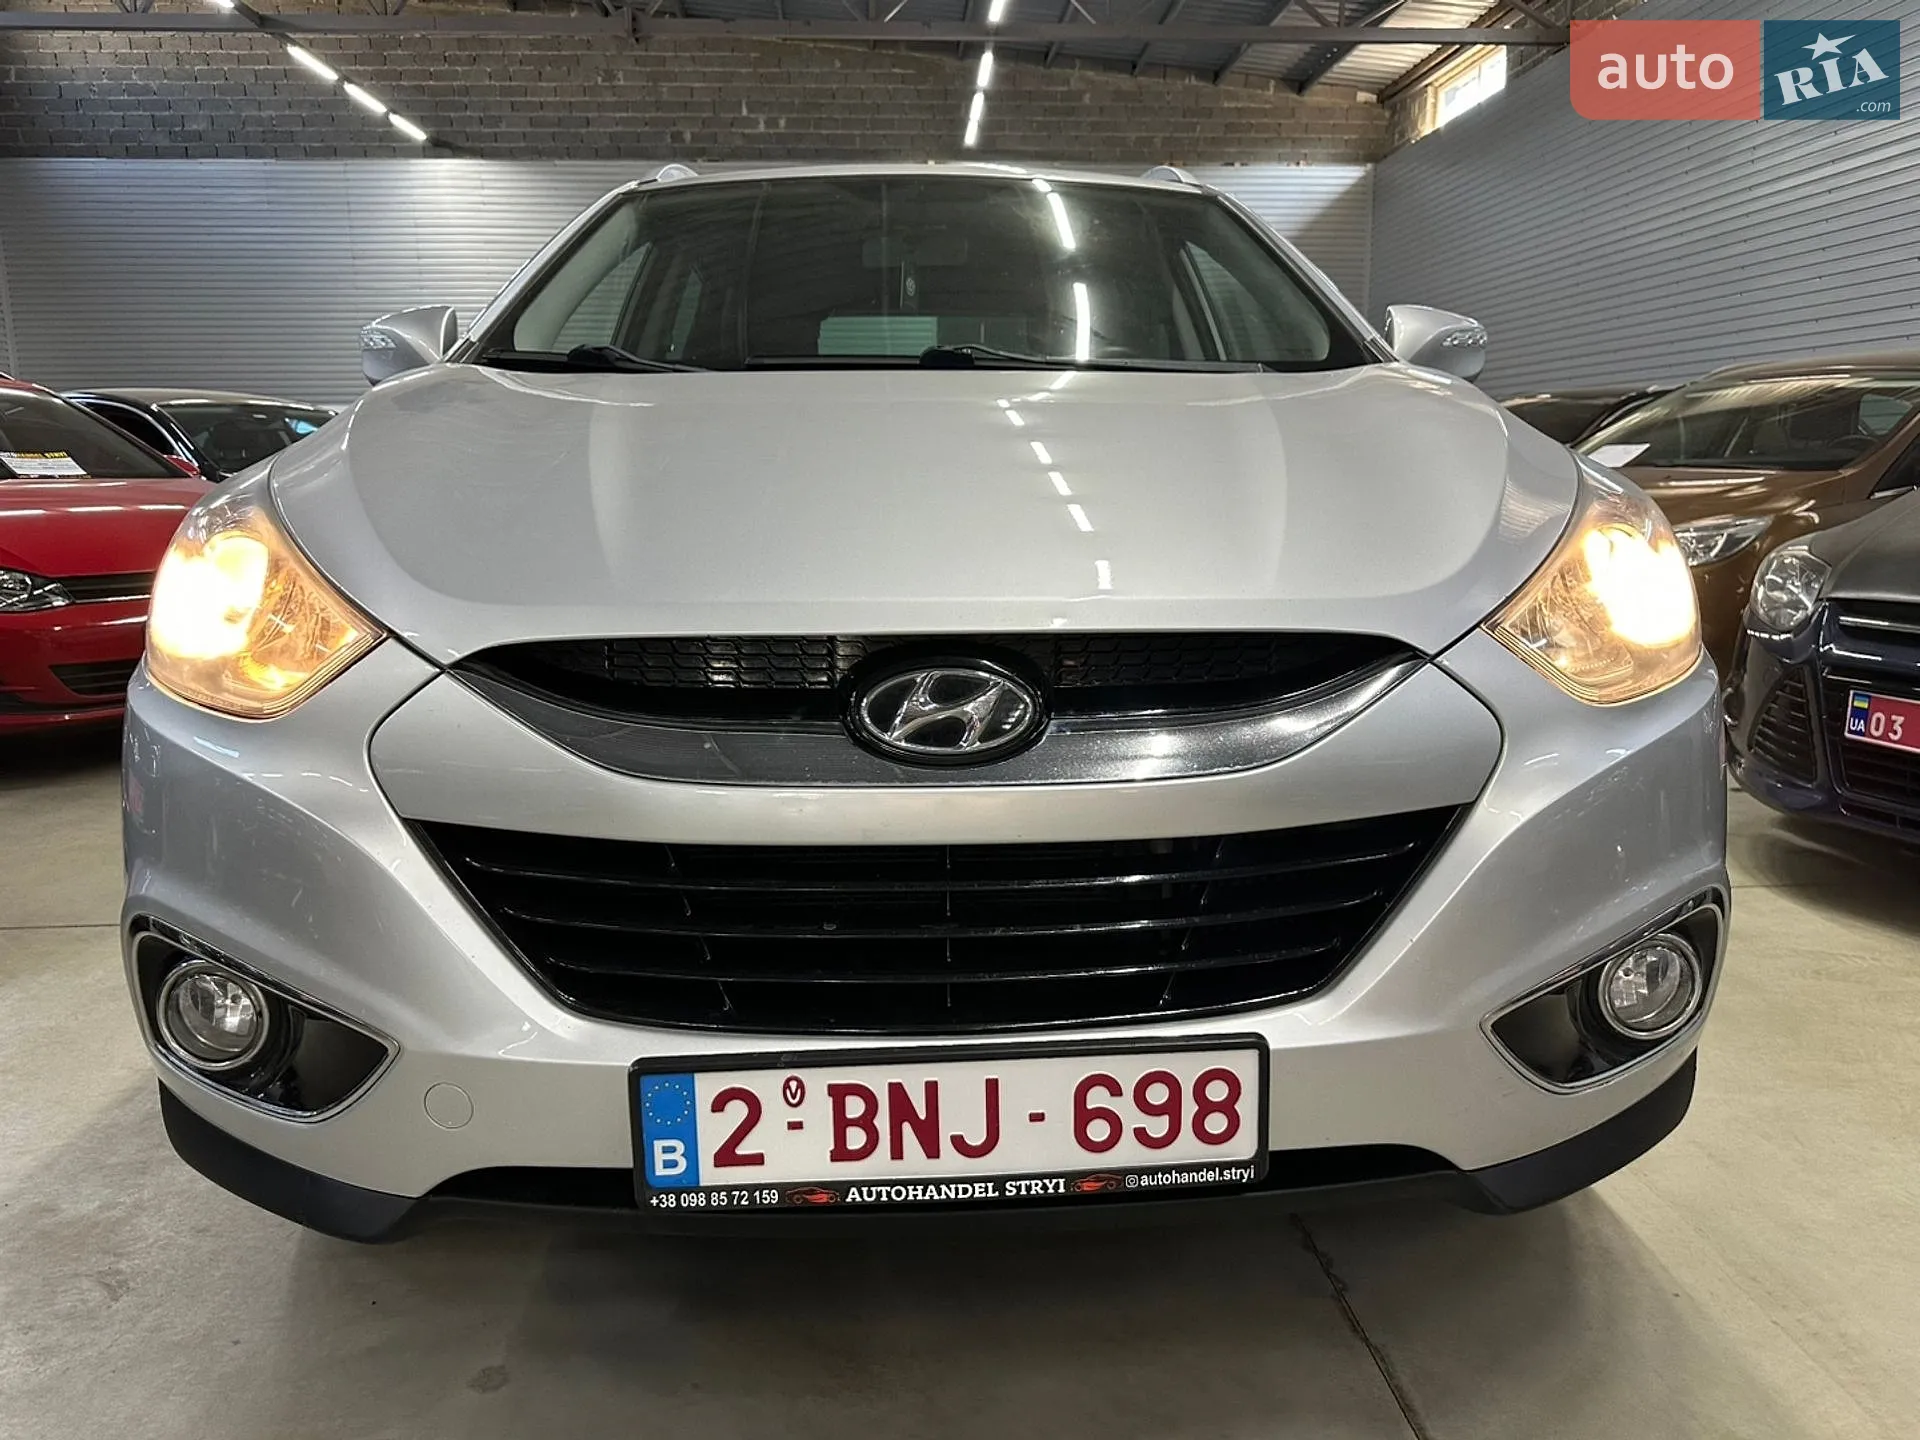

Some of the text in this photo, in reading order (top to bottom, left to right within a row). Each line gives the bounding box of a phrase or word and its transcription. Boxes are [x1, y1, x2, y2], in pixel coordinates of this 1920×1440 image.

[1850, 717, 1865, 732] UA
[1870, 712, 1904, 740] 03
[653, 1139, 687, 1176] B
[650, 1189, 779, 1208] +38 098 85 72 159
[845, 1178, 1066, 1202] AUTOHANDEL STRYI
